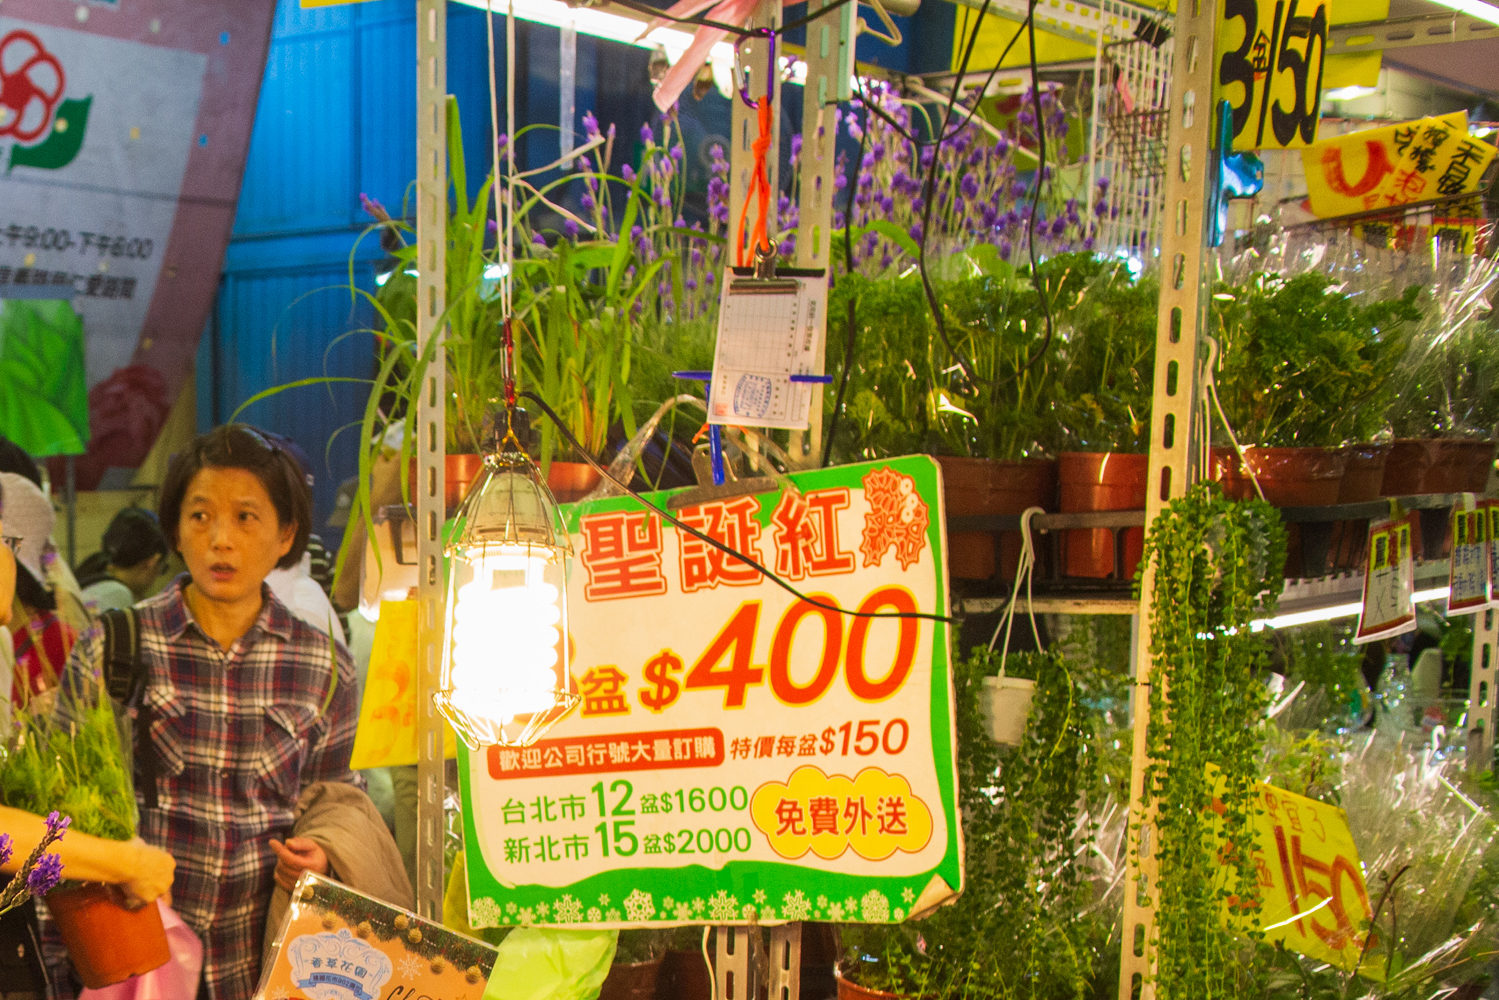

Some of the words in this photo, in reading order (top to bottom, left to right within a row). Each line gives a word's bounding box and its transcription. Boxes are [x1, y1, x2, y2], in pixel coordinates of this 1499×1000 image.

[580, 487, 855, 602] 聖誕紅
[499, 736, 716, 772] 歡迎公司行號大量訂購
[775, 796, 908, 836] 免費外送
